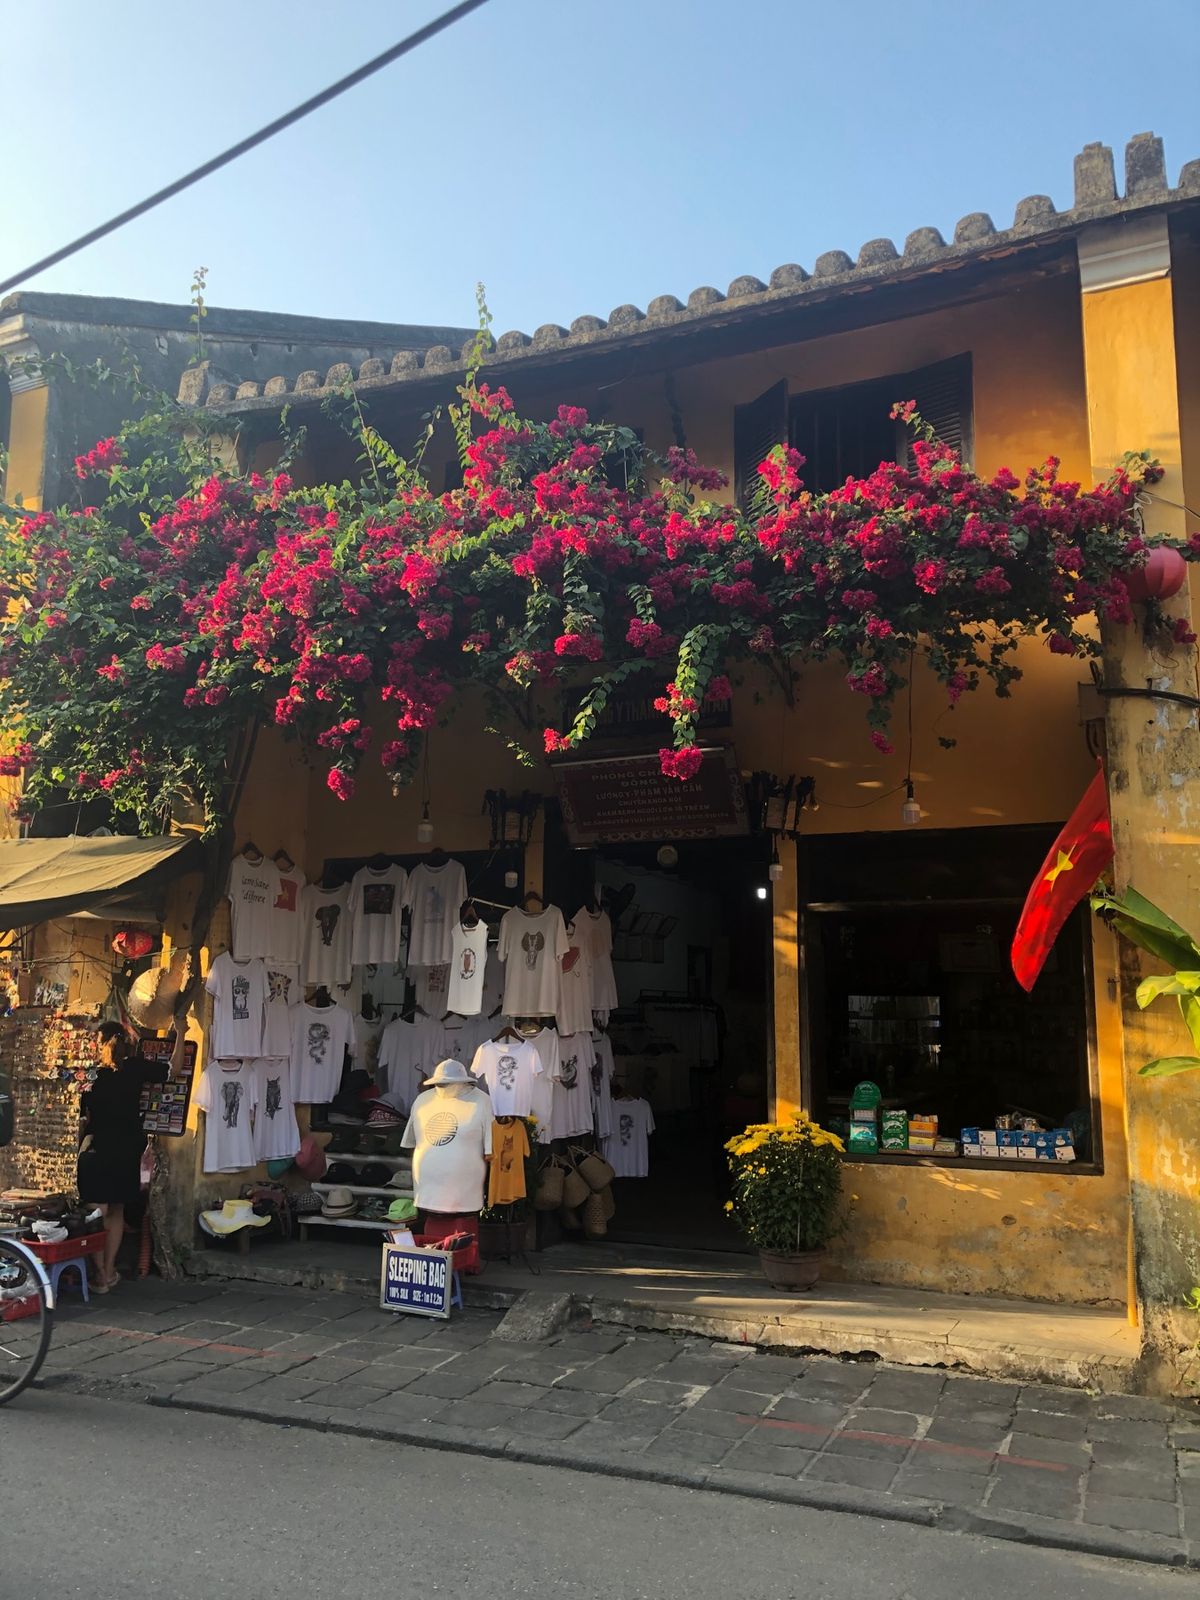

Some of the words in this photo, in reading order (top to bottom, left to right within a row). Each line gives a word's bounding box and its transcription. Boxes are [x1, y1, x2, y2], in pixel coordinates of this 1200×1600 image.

[389, 1256, 427, 1285] SLEEPING
[428, 1262, 445, 1288] BAG
[400, 1287, 409, 1300] SILK
